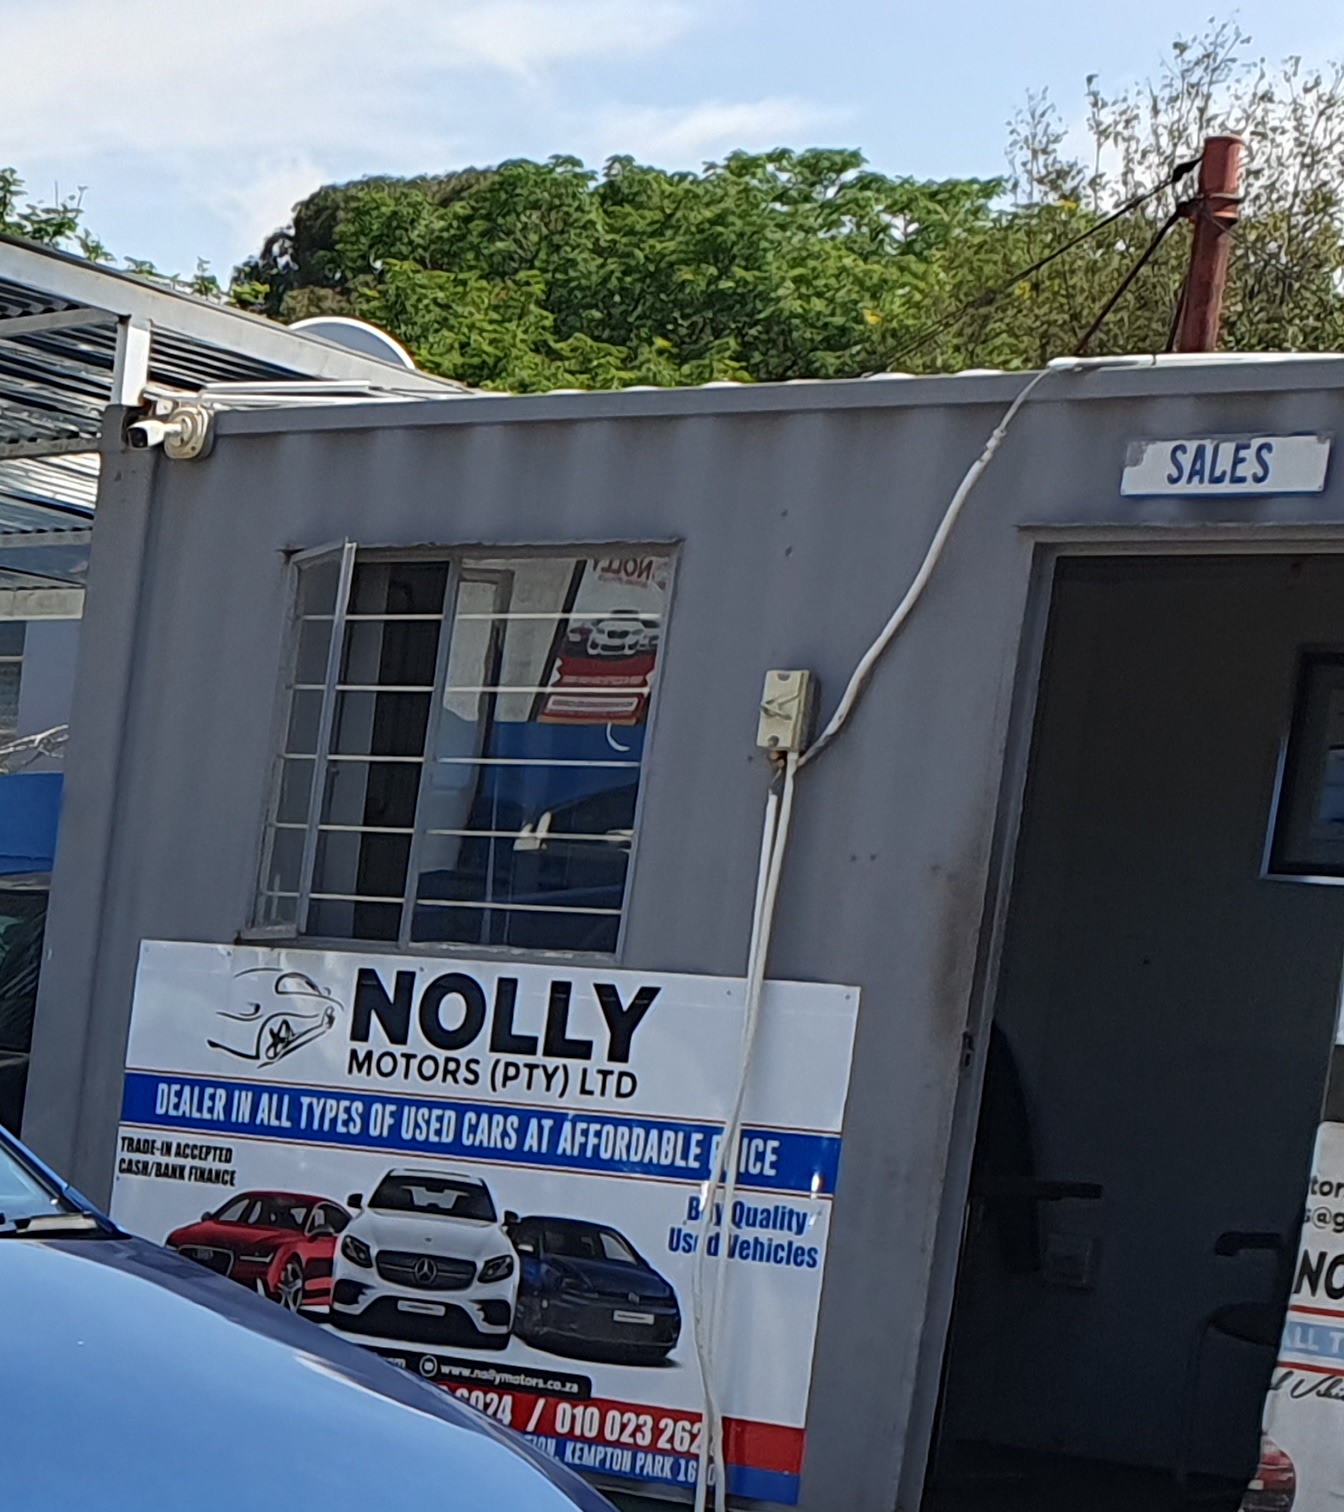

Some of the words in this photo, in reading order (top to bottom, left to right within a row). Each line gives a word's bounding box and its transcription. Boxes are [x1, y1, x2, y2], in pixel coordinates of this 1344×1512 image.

[1167, 442, 1274, 486] SALES
[349, 966, 663, 1064] NOLLY
[347, 1048, 481, 1086] MOTORS
[490, 1057, 570, 1098] (PTY)
[579, 1067, 638, 1099] LTD
[120, 1136, 173, 1158] TRADE-IN
[174, 1141, 233, 1164] ACCEPTED
[155, 1082, 226, 1122] DEALER
[231, 1090, 251, 1124] IN
[256, 1090, 292, 1129] ALL
[301, 1096, 362, 1135] TYPES
[369, 1102, 394, 1138] OF
[401, 1106, 457, 1143] USED
[461, 1106, 519, 1150] CARS
[523, 1117, 554, 1155] AT
[557, 1120, 704, 1169] AFFORDABLE
[709, 1134, 780, 1176] PICE
[118, 1157, 187, 1181] CASH/BANK
[188, 1165, 237, 1187] FINANCE
[687, 1195, 724, 1227] By
[731, 1200, 807, 1236] Quality
[727, 1233, 819, 1269] Vehicles
[439, 1364, 579, 1393] www.nollymotors.co.za
[555, 1402, 600, 1438] 010
[604, 1410, 654, 1447] 023
[657, 1417, 715, 1455] 262
[564, 1440, 632, 1472] KEMPTON
[635, 1452, 674, 1480] PARK
[676, 1458, 715, 1486] 160
